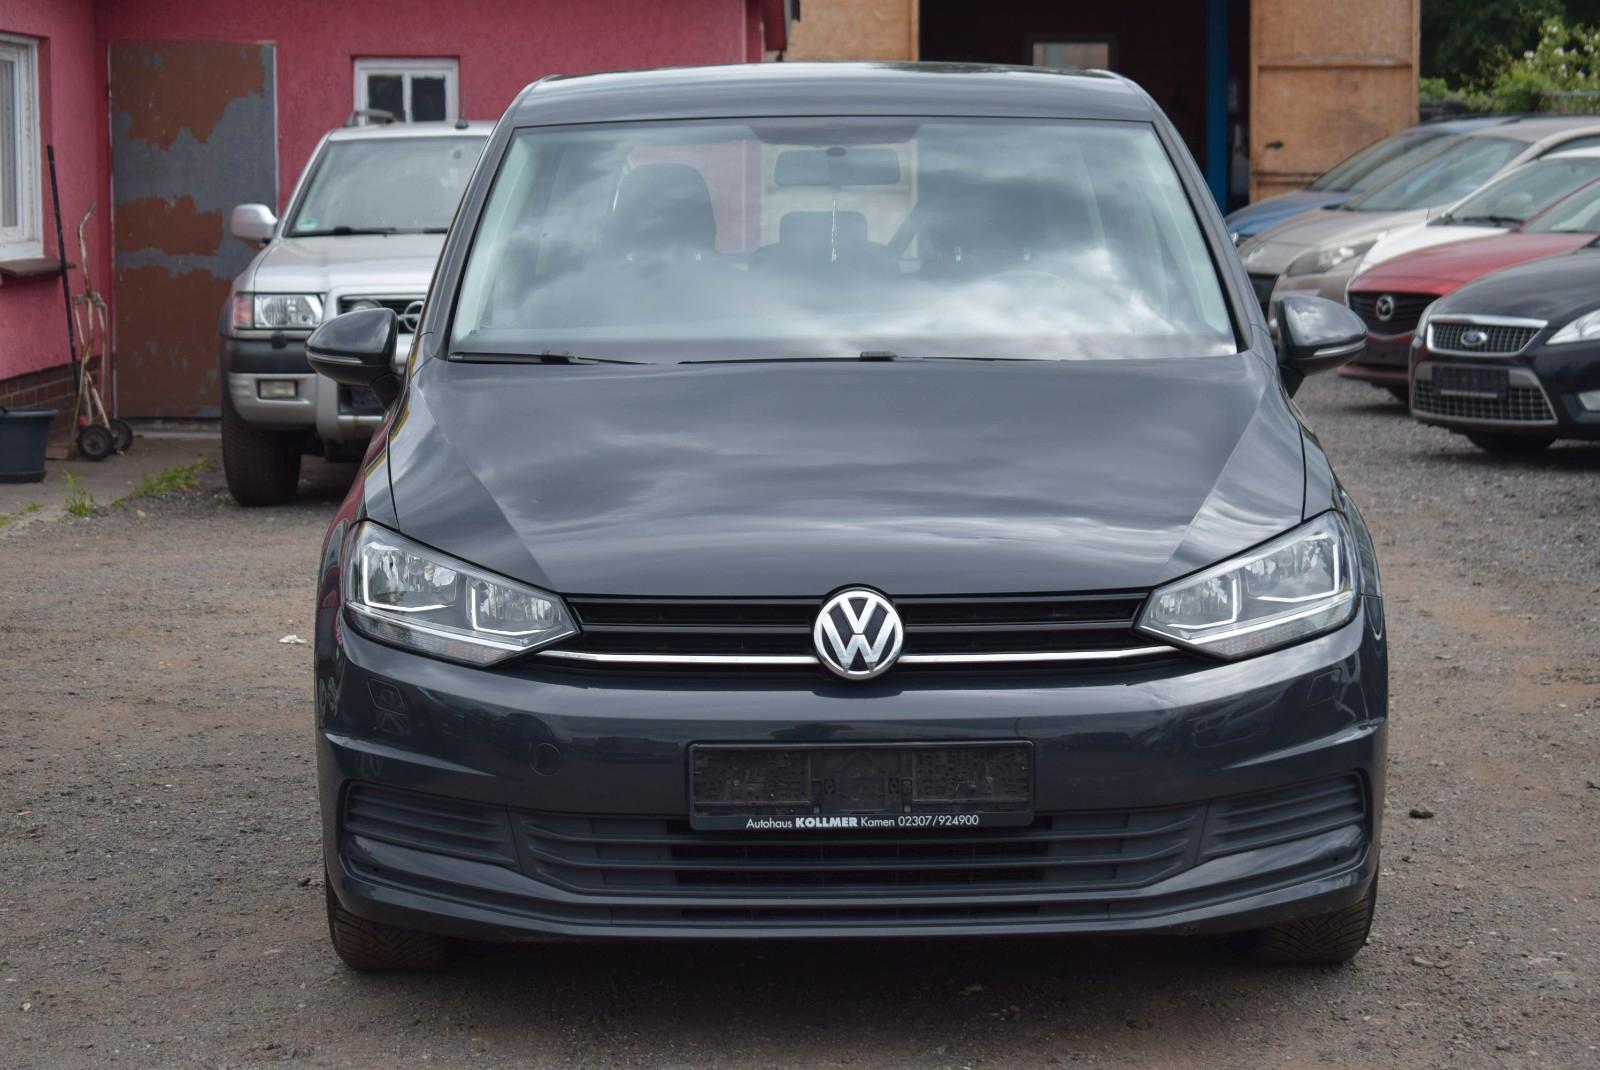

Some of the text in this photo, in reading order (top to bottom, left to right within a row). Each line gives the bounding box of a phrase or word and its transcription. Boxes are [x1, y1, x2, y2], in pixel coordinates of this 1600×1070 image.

[817, 592, 900, 676] VW
[745, 814, 980, 829] Autohaus KOLLMER Kamen 02307/924900
